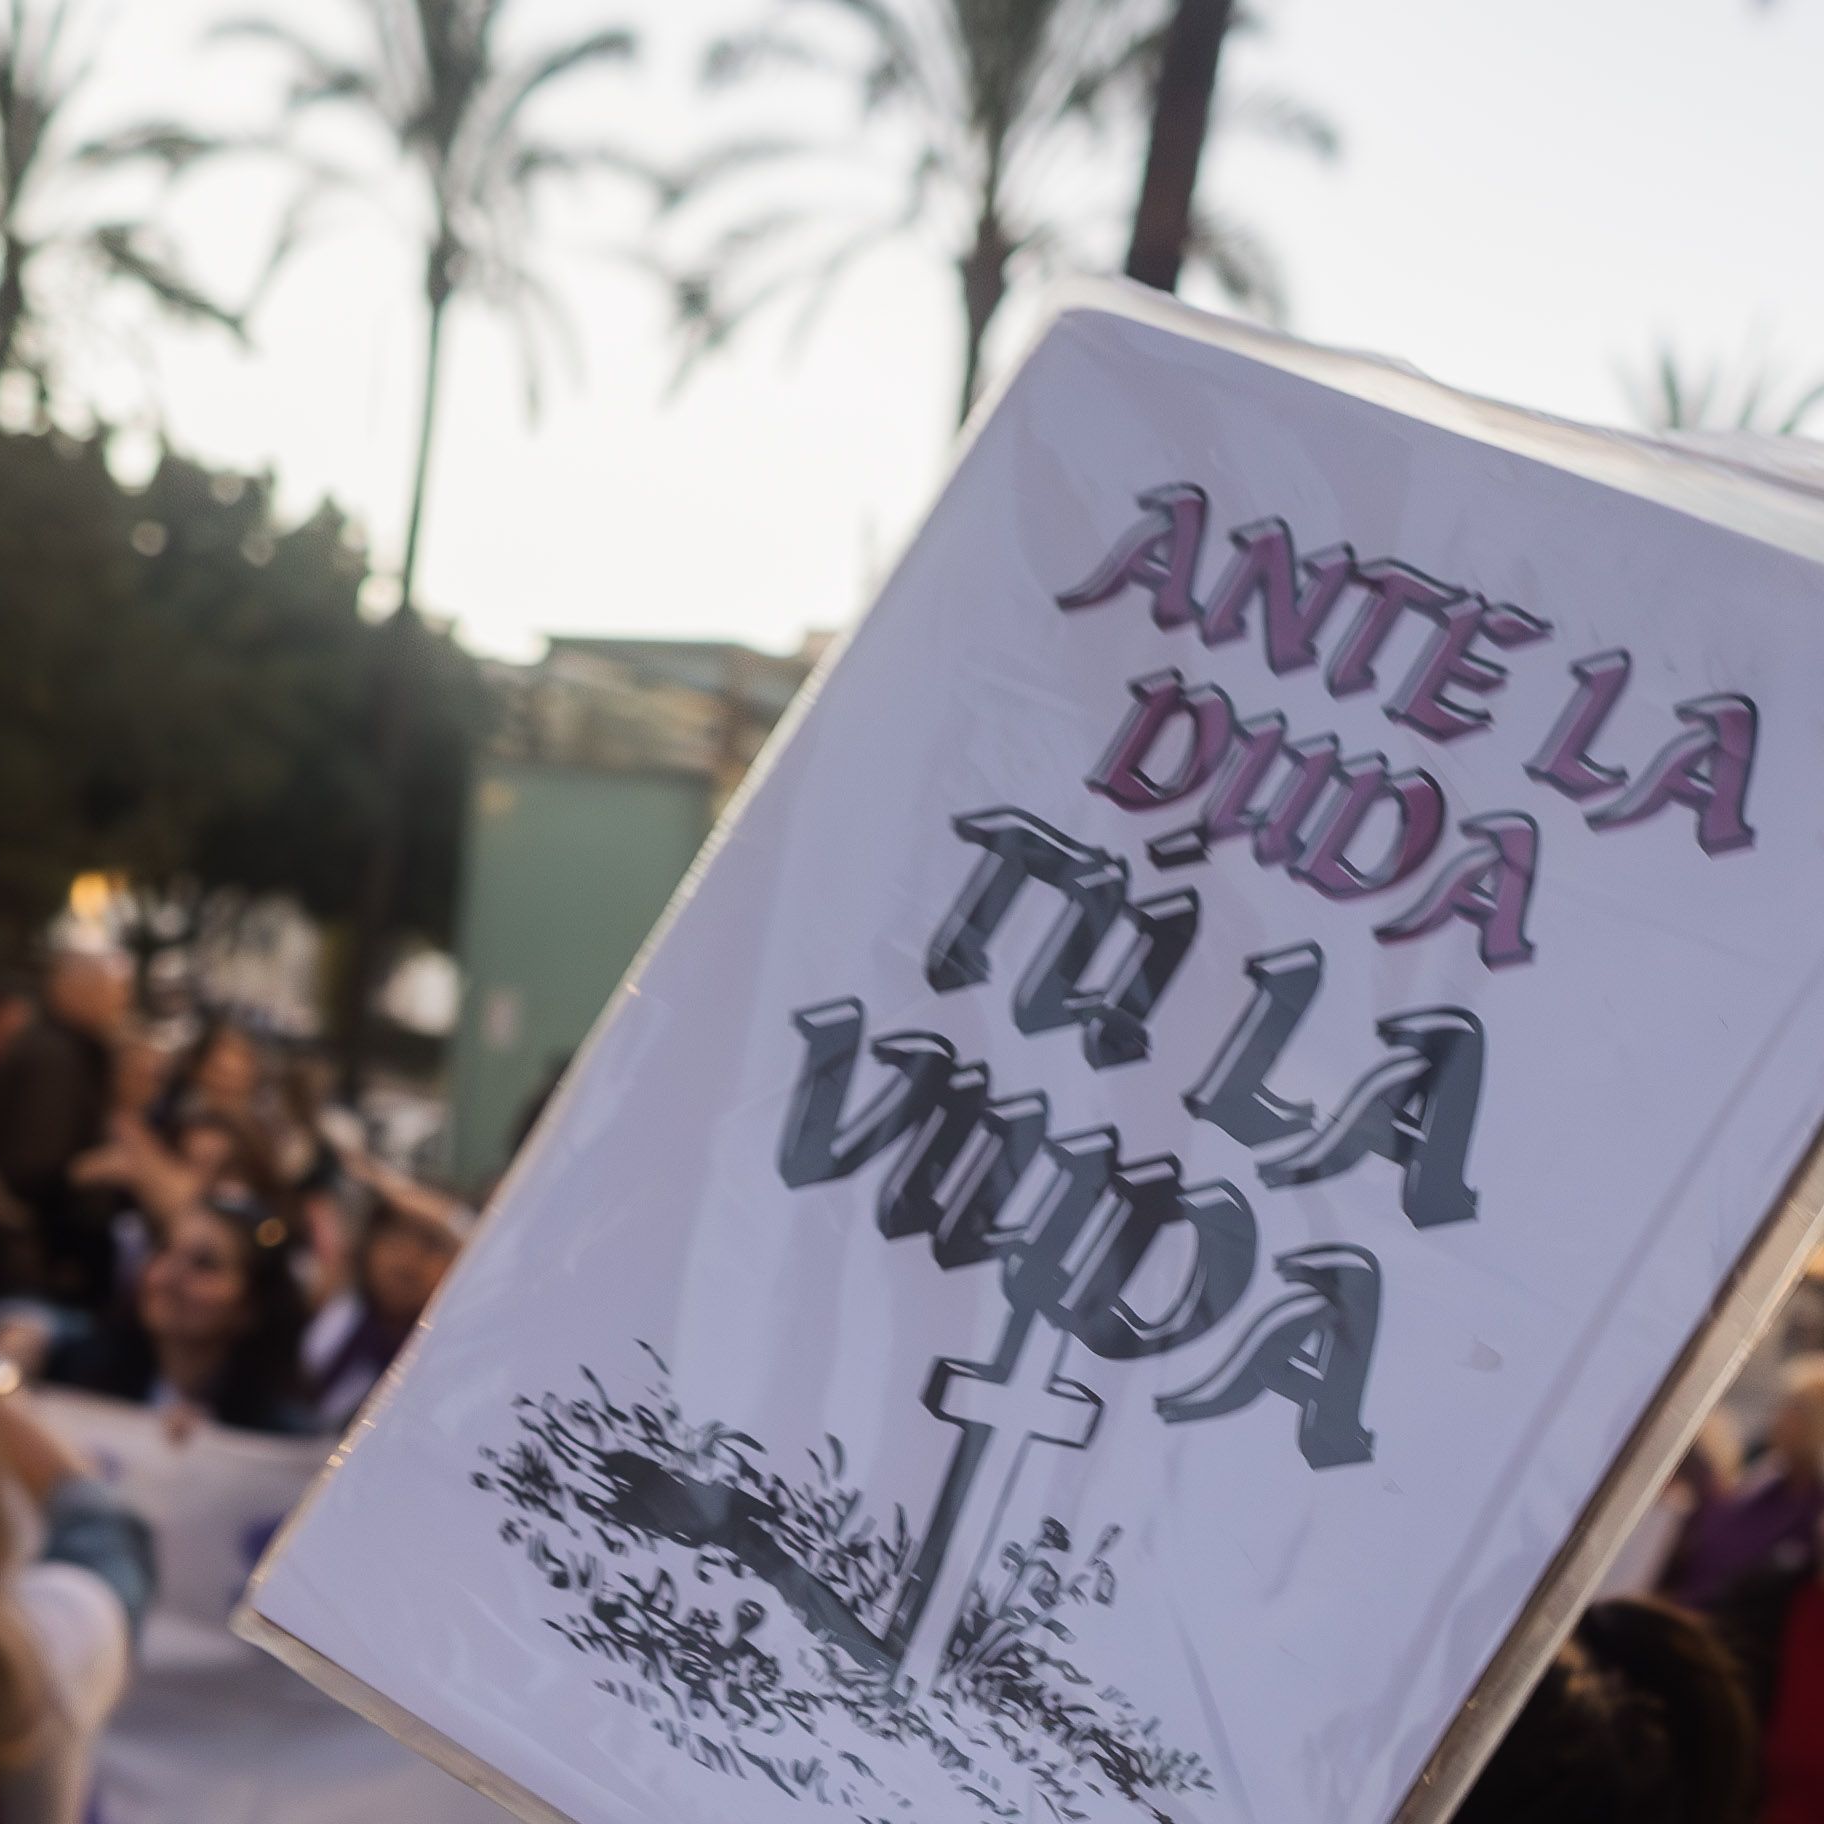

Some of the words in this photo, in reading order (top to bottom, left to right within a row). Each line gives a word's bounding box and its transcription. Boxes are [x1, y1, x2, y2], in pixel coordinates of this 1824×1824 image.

[1054, 482, 1553, 743] ANTE
[1523, 647, 1759, 857] LA
[1084, 667, 1539, 970] DUDA
[776, 995, 1382, 1469] VIUDA
[1181, 940, 1485, 1229] LA
